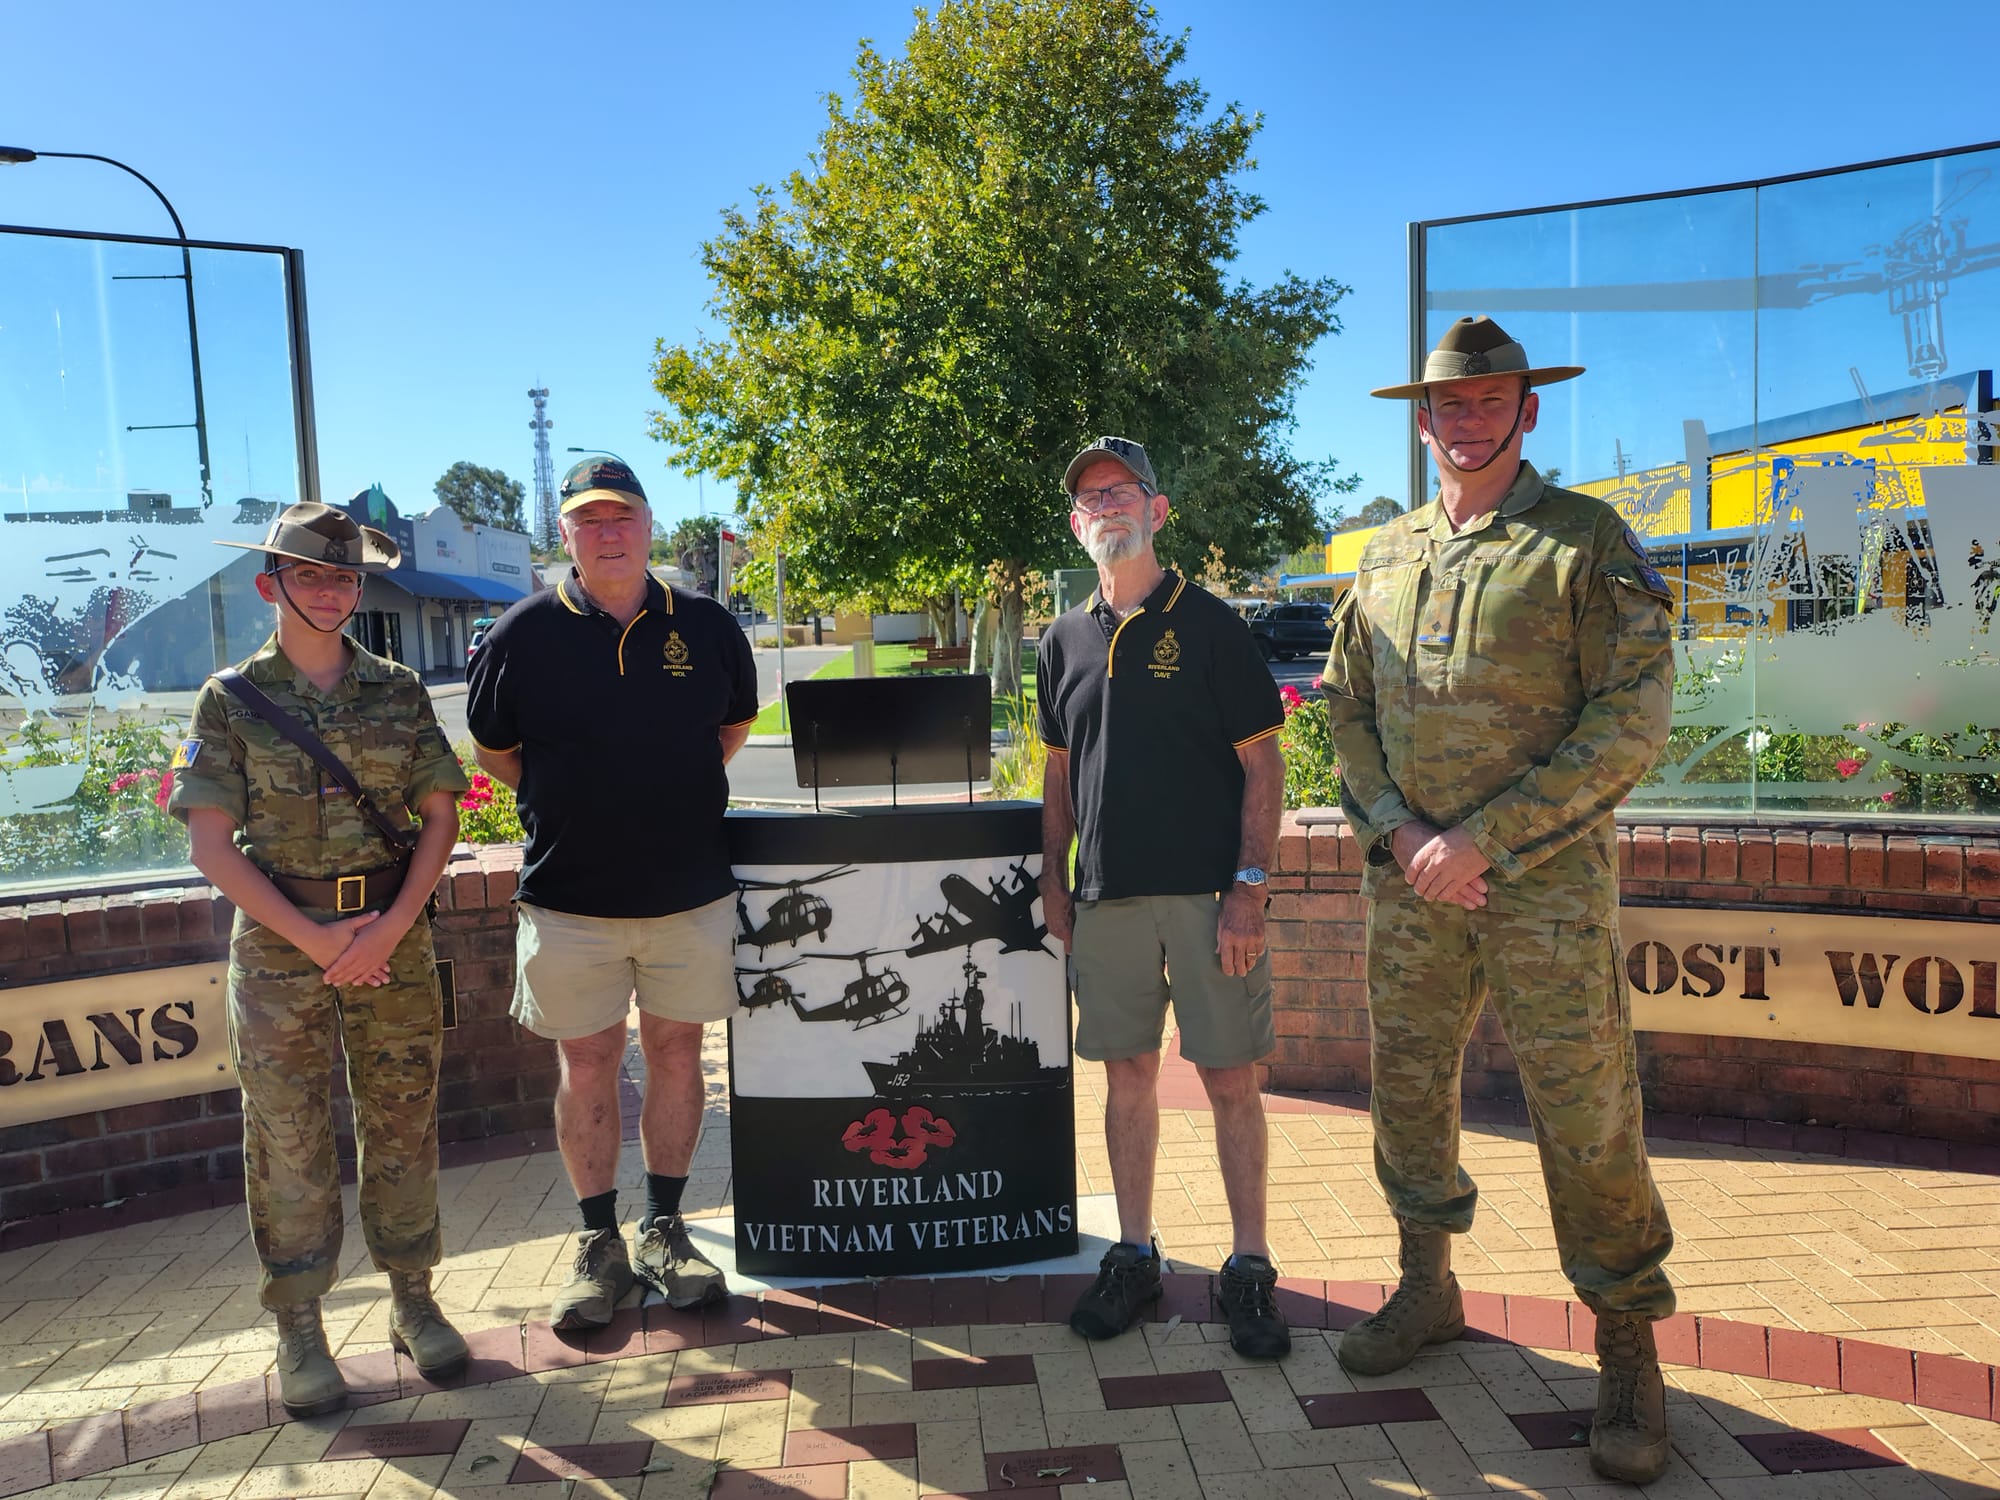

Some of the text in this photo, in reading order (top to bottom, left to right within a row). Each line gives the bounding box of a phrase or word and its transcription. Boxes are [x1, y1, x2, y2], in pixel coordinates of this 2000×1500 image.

[813, 1170, 1003, 1207] RIVERLAND
[743, 1204, 1073, 1253] VIETNAM VETERANS
[716, 1382, 763, 1390] BRANCH
[754, 1472, 807, 1483] MICHAEL
